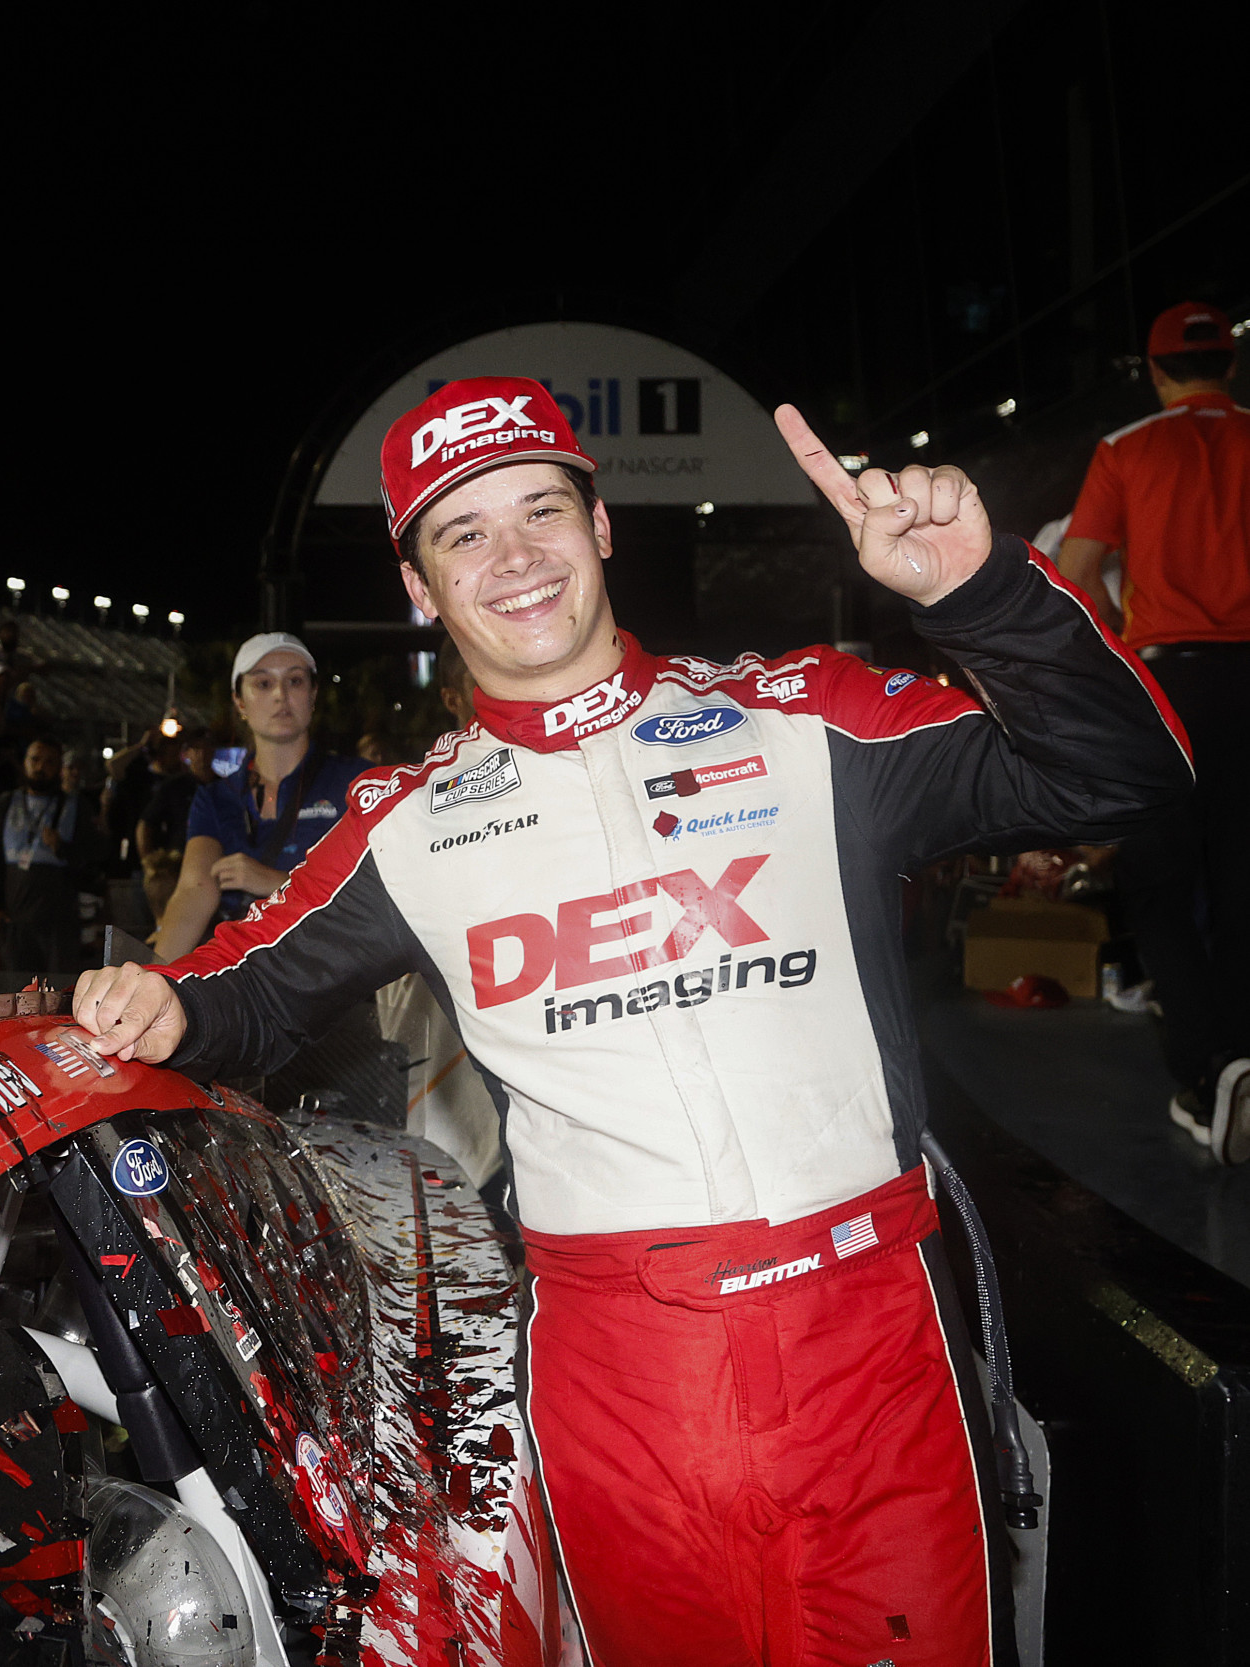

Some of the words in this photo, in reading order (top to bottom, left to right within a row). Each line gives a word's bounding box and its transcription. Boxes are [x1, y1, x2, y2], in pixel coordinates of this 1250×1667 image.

[410, 395, 537, 469] DEX
[440, 426, 556, 463] imaging
[619, 456, 704, 475] NASCAR
[542, 671, 628, 737] DEX
[573, 690, 643, 738] imaging
[654, 711, 724, 740] Ford
[445, 785, 468, 802] CUP
[469, 771, 506, 795] SERIES
[461, 754, 501, 784] NASCAR
[654, 780, 676, 792] Ford
[695, 761, 762, 785] Motorcraft
[429, 813, 540, 854] GOODYEAR
[686, 811, 735, 833] Quick
[737, 806, 779, 823] Lane
[701, 829, 717, 838] TIRE
[725, 824, 746, 833] AUTO
[746, 819, 776, 829] CENTER
[466, 853, 771, 1010] DEX
[544, 948, 817, 1034] imaging
[125, 1146, 164, 1188] Ford
[704, 1256, 778, 1287] Harrison
[717, 1252, 825, 1295] BURTON
